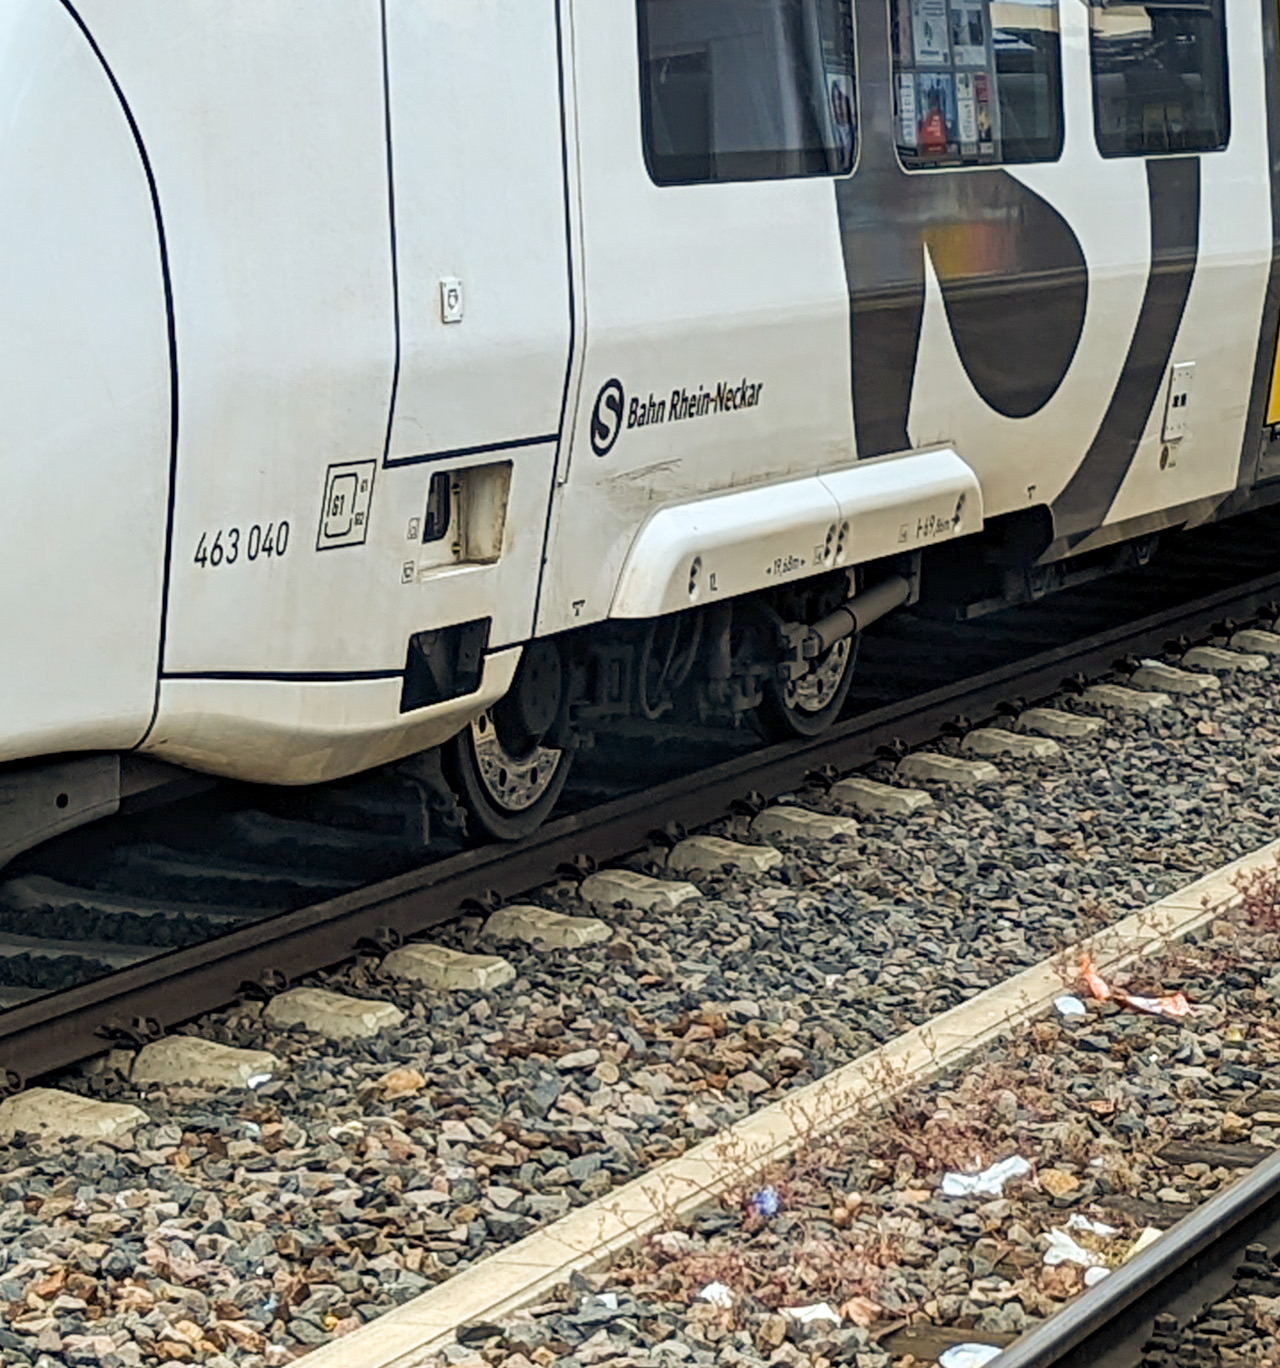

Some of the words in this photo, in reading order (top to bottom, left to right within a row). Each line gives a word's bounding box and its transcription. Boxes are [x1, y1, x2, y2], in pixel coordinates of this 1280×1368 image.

[626, 393, 666, 429] Bahn
[668, 378, 764, 421] Rhein-Neckar
[194, 528, 240, 568] 463
[247, 521, 289, 562] 040
